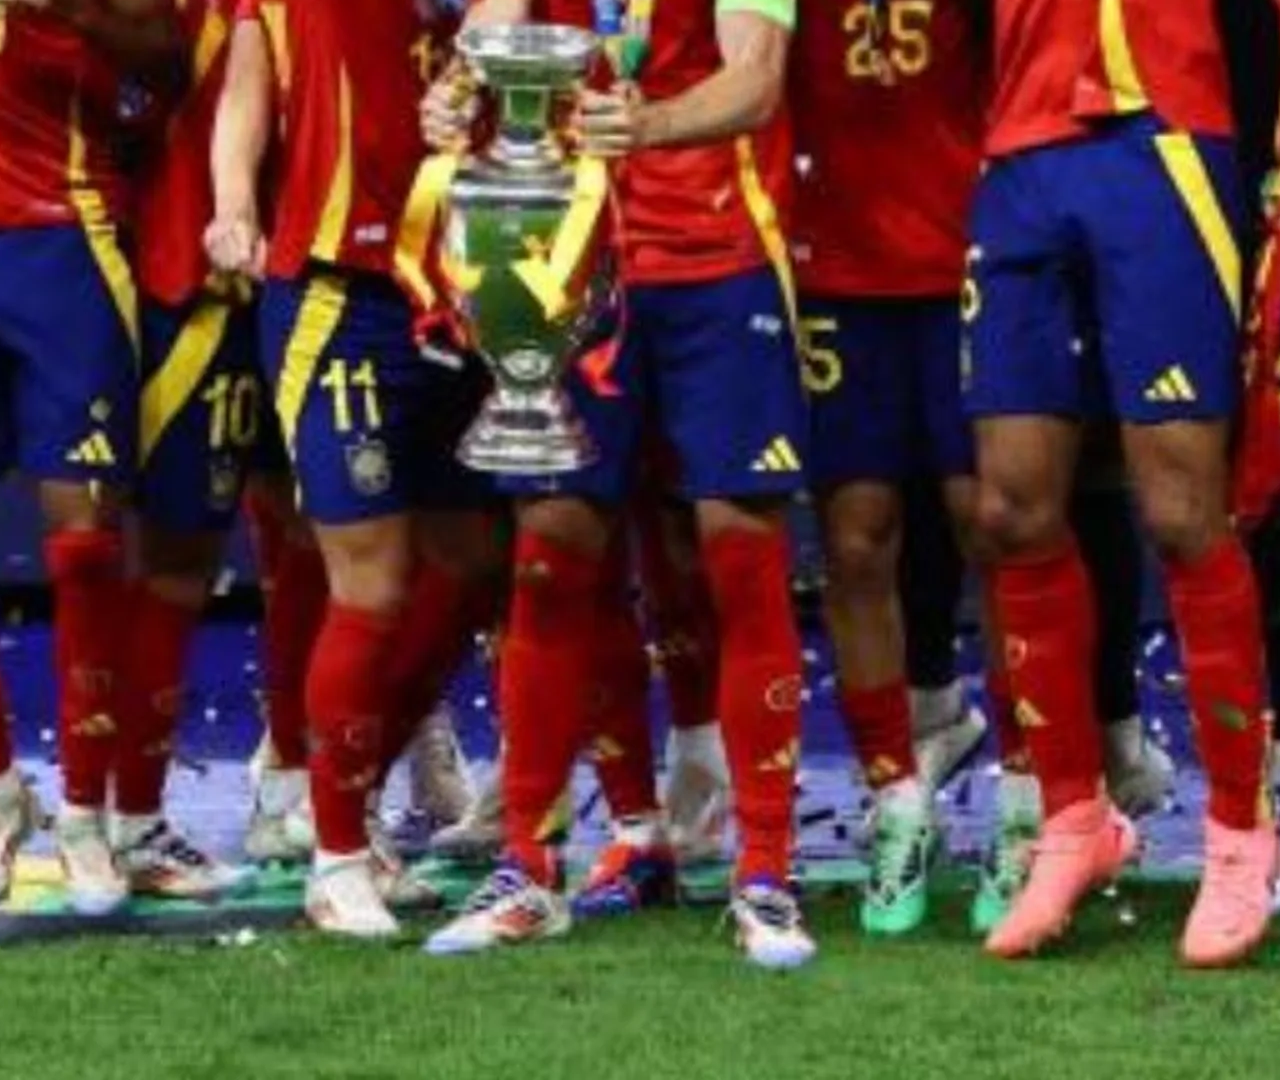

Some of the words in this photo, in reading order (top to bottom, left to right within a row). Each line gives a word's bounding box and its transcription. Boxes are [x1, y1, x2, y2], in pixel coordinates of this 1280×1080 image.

[410, 32, 433, 81] 1
[800, 319, 842, 392] 5
[204, 374, 259, 447] 10
[320, 358, 383, 432] 11
